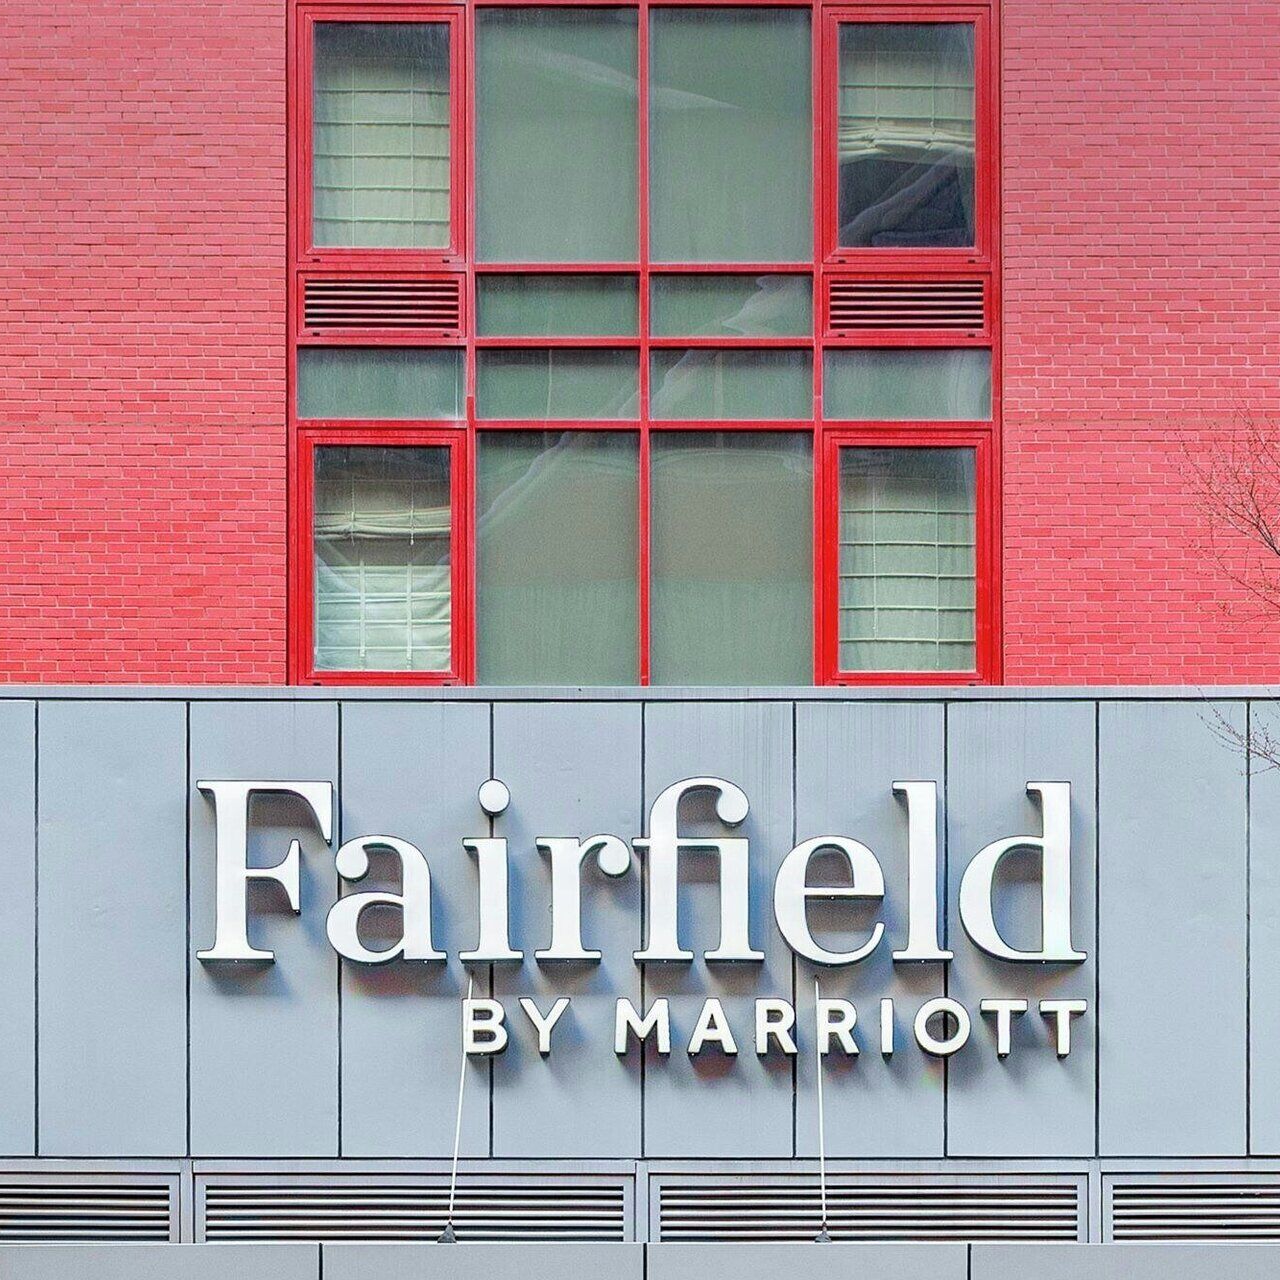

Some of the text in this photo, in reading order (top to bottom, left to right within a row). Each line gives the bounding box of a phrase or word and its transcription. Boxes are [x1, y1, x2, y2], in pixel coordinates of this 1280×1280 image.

[195, 775, 1087, 967] Fairfield
[464, 996, 1089, 1057] BY MARRIOTT
